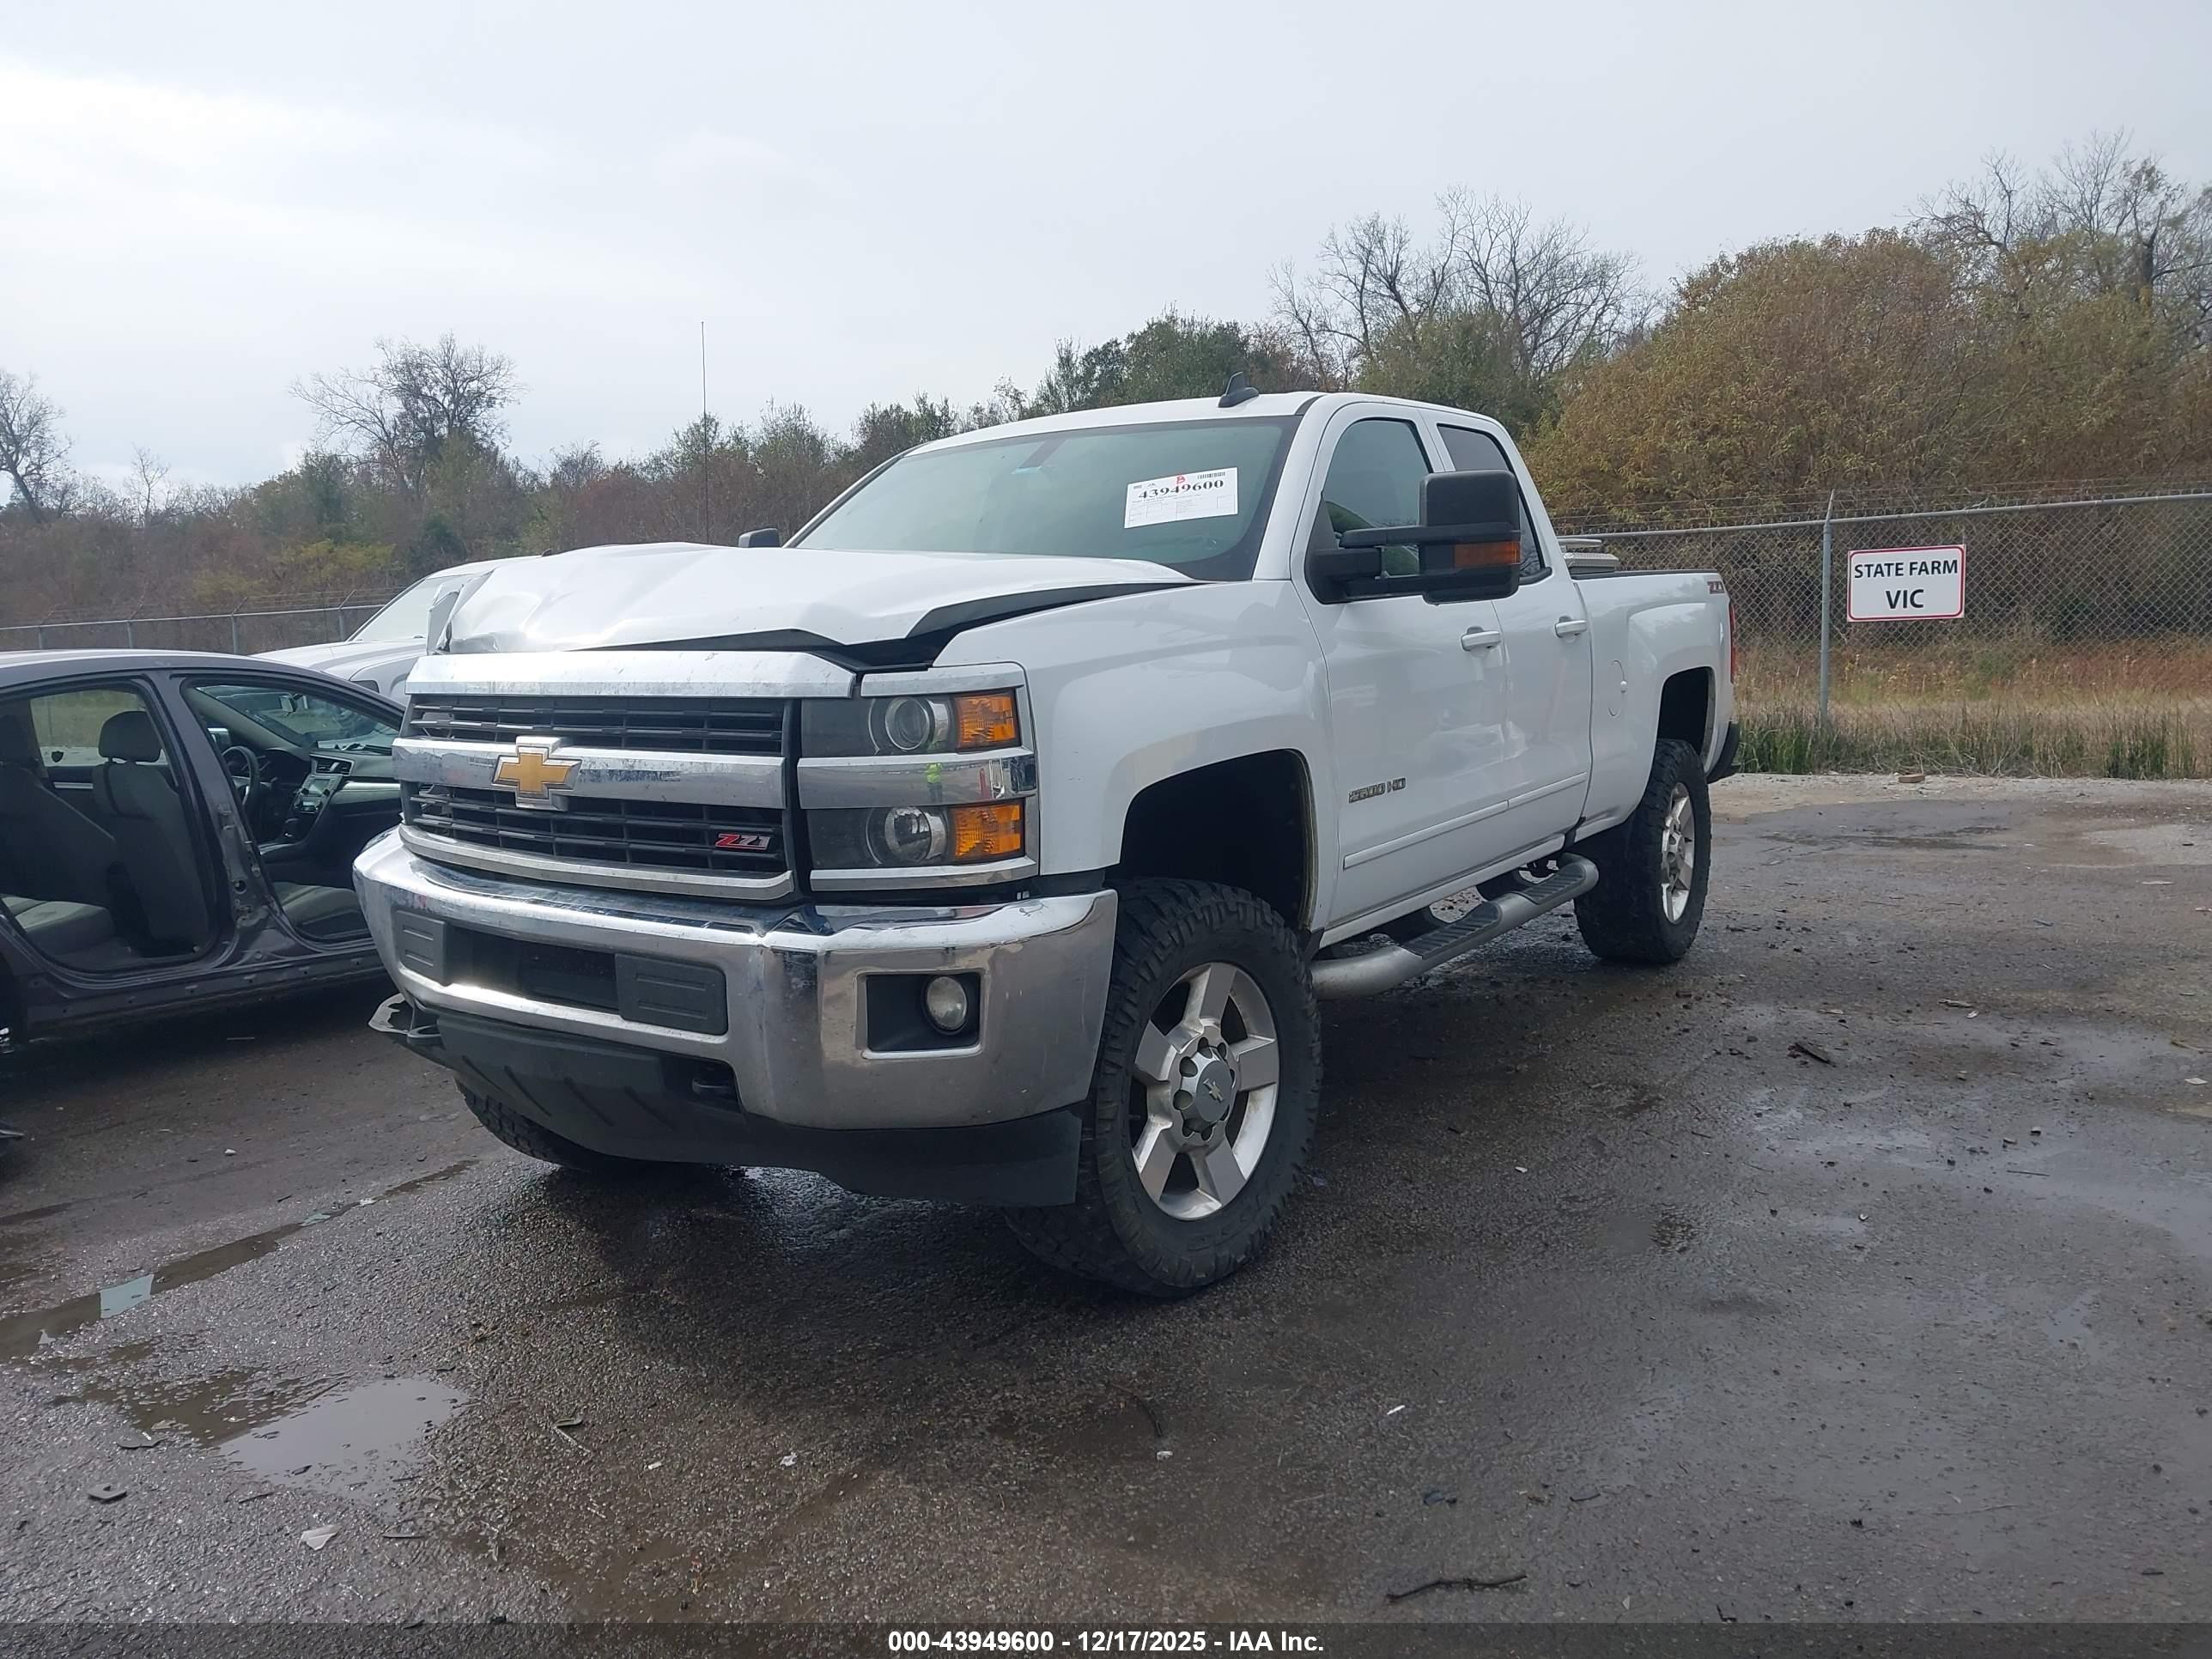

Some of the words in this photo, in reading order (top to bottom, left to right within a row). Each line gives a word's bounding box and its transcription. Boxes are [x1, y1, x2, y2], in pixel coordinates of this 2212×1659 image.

[1138, 479, 1224, 499] 43949600
[1854, 562, 1904, 579] STATE
[1909, 559, 1958, 576] FARM
[1885, 588, 1924, 610] VIC
[714, 833, 771, 851] Z71
